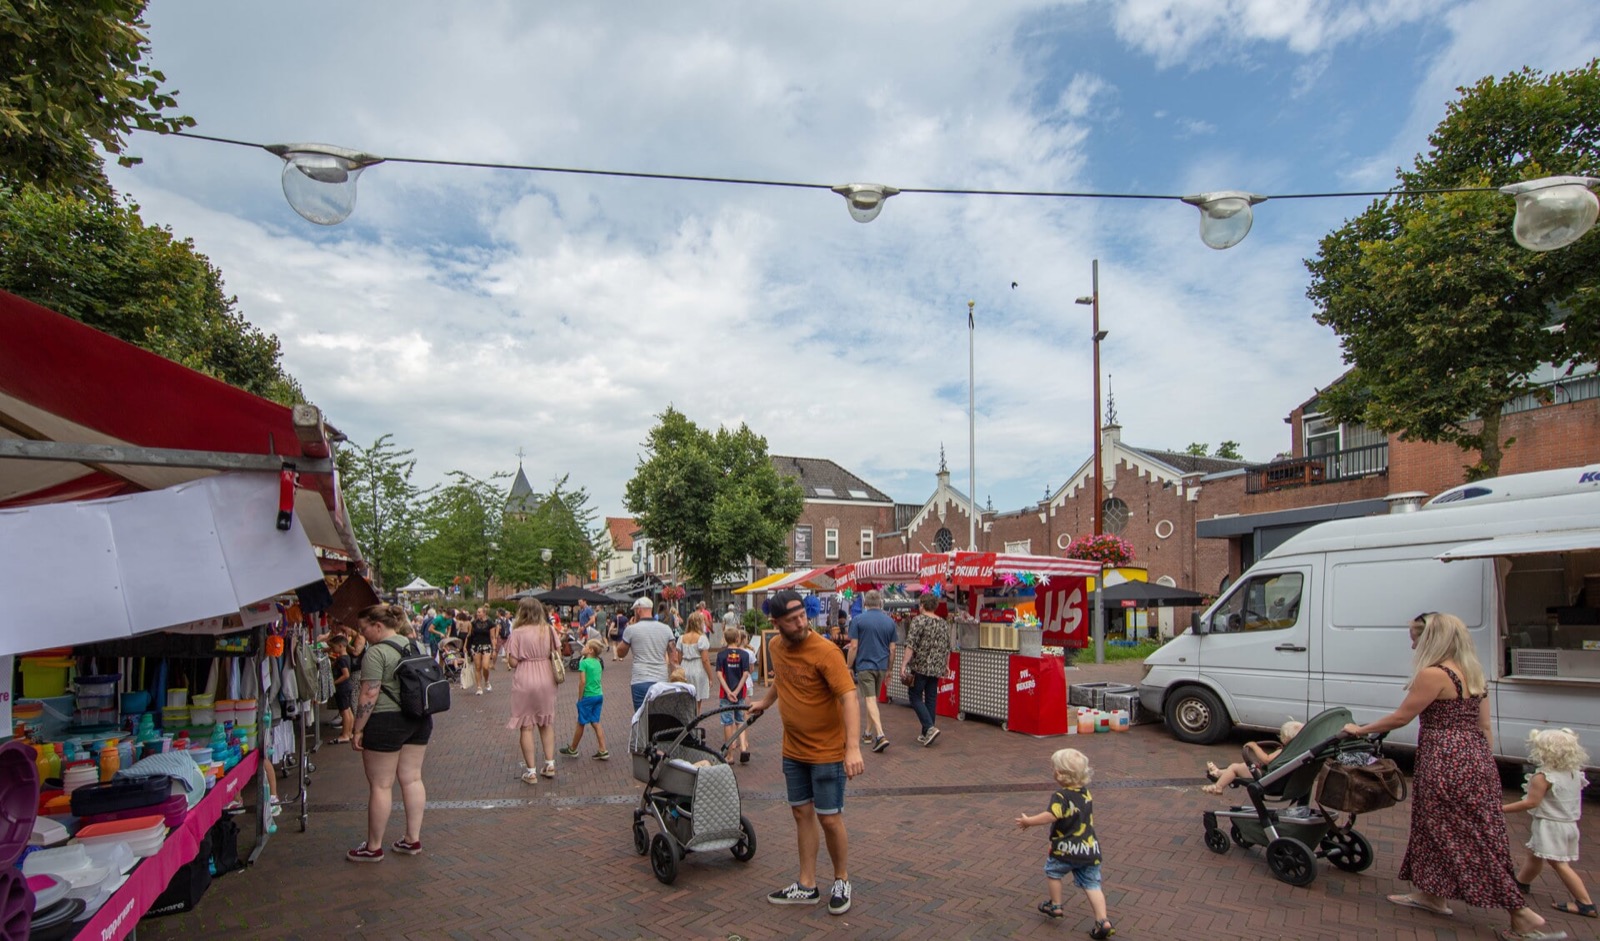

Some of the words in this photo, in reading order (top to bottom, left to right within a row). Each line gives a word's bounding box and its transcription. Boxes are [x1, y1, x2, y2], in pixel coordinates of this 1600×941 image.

[919, 564, 937, 578] DRINK
[937, 561, 947, 574] IJS
[954, 565, 979, 577] DRINK
[980, 565, 994, 577] IJS
[1042, 588, 1082, 634] IJS
